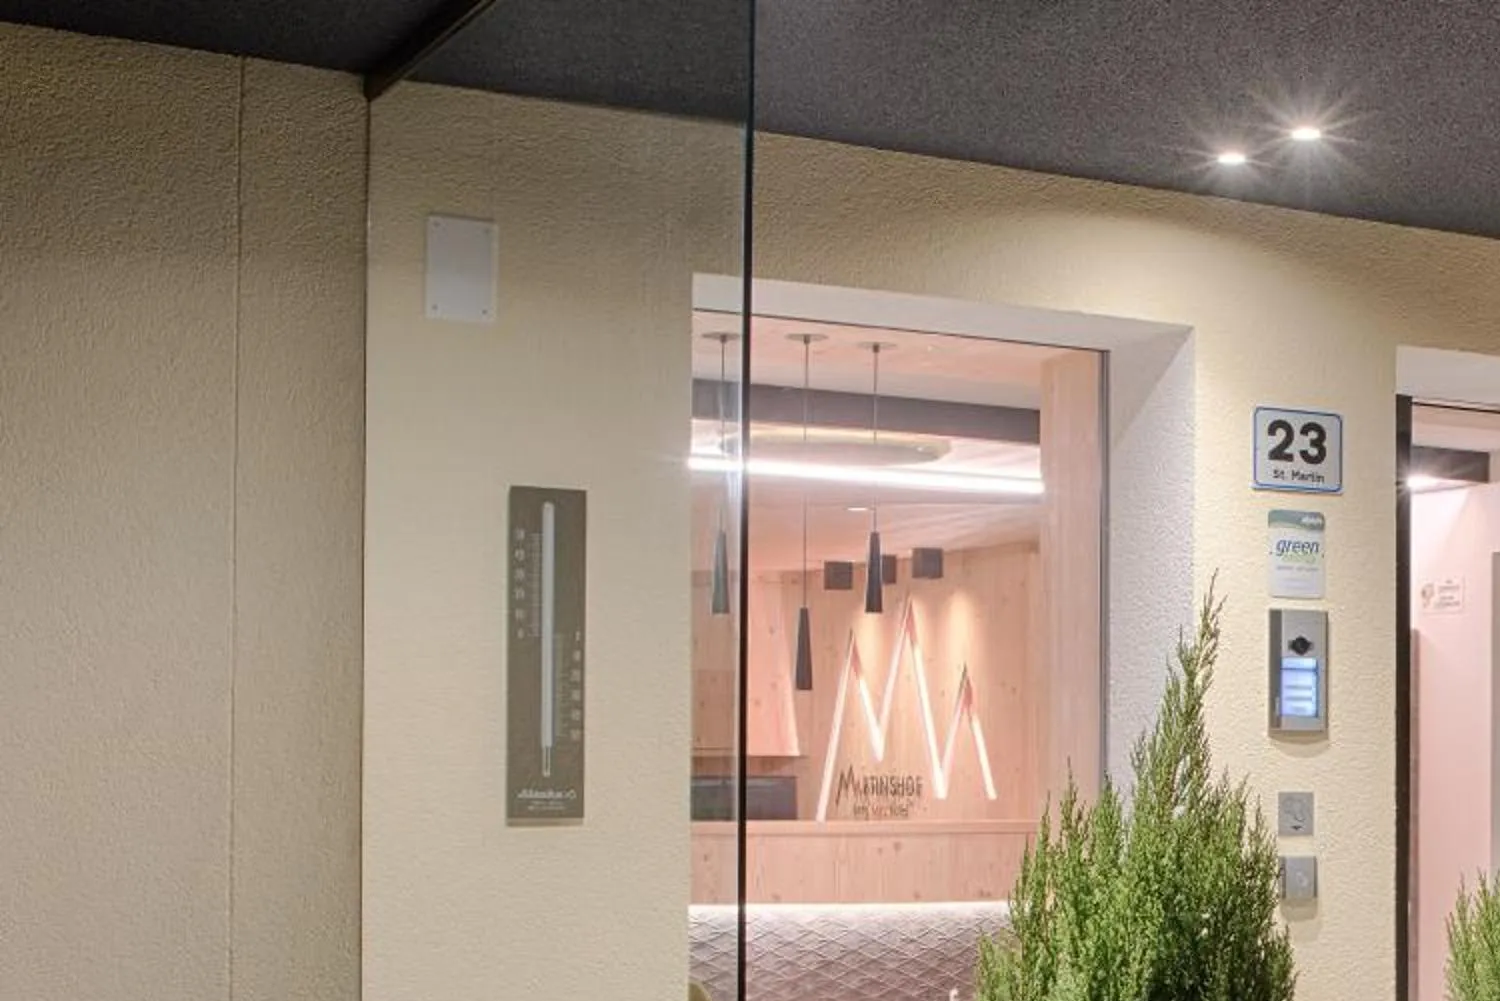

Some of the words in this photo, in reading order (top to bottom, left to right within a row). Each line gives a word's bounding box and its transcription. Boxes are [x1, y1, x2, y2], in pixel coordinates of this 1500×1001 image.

[1267, 418, 1327, 465] 23
[1273, 469, 1287, 481] St.
[1291, 469, 1325, 483] Martin
[1276, 539, 1320, 556] green
